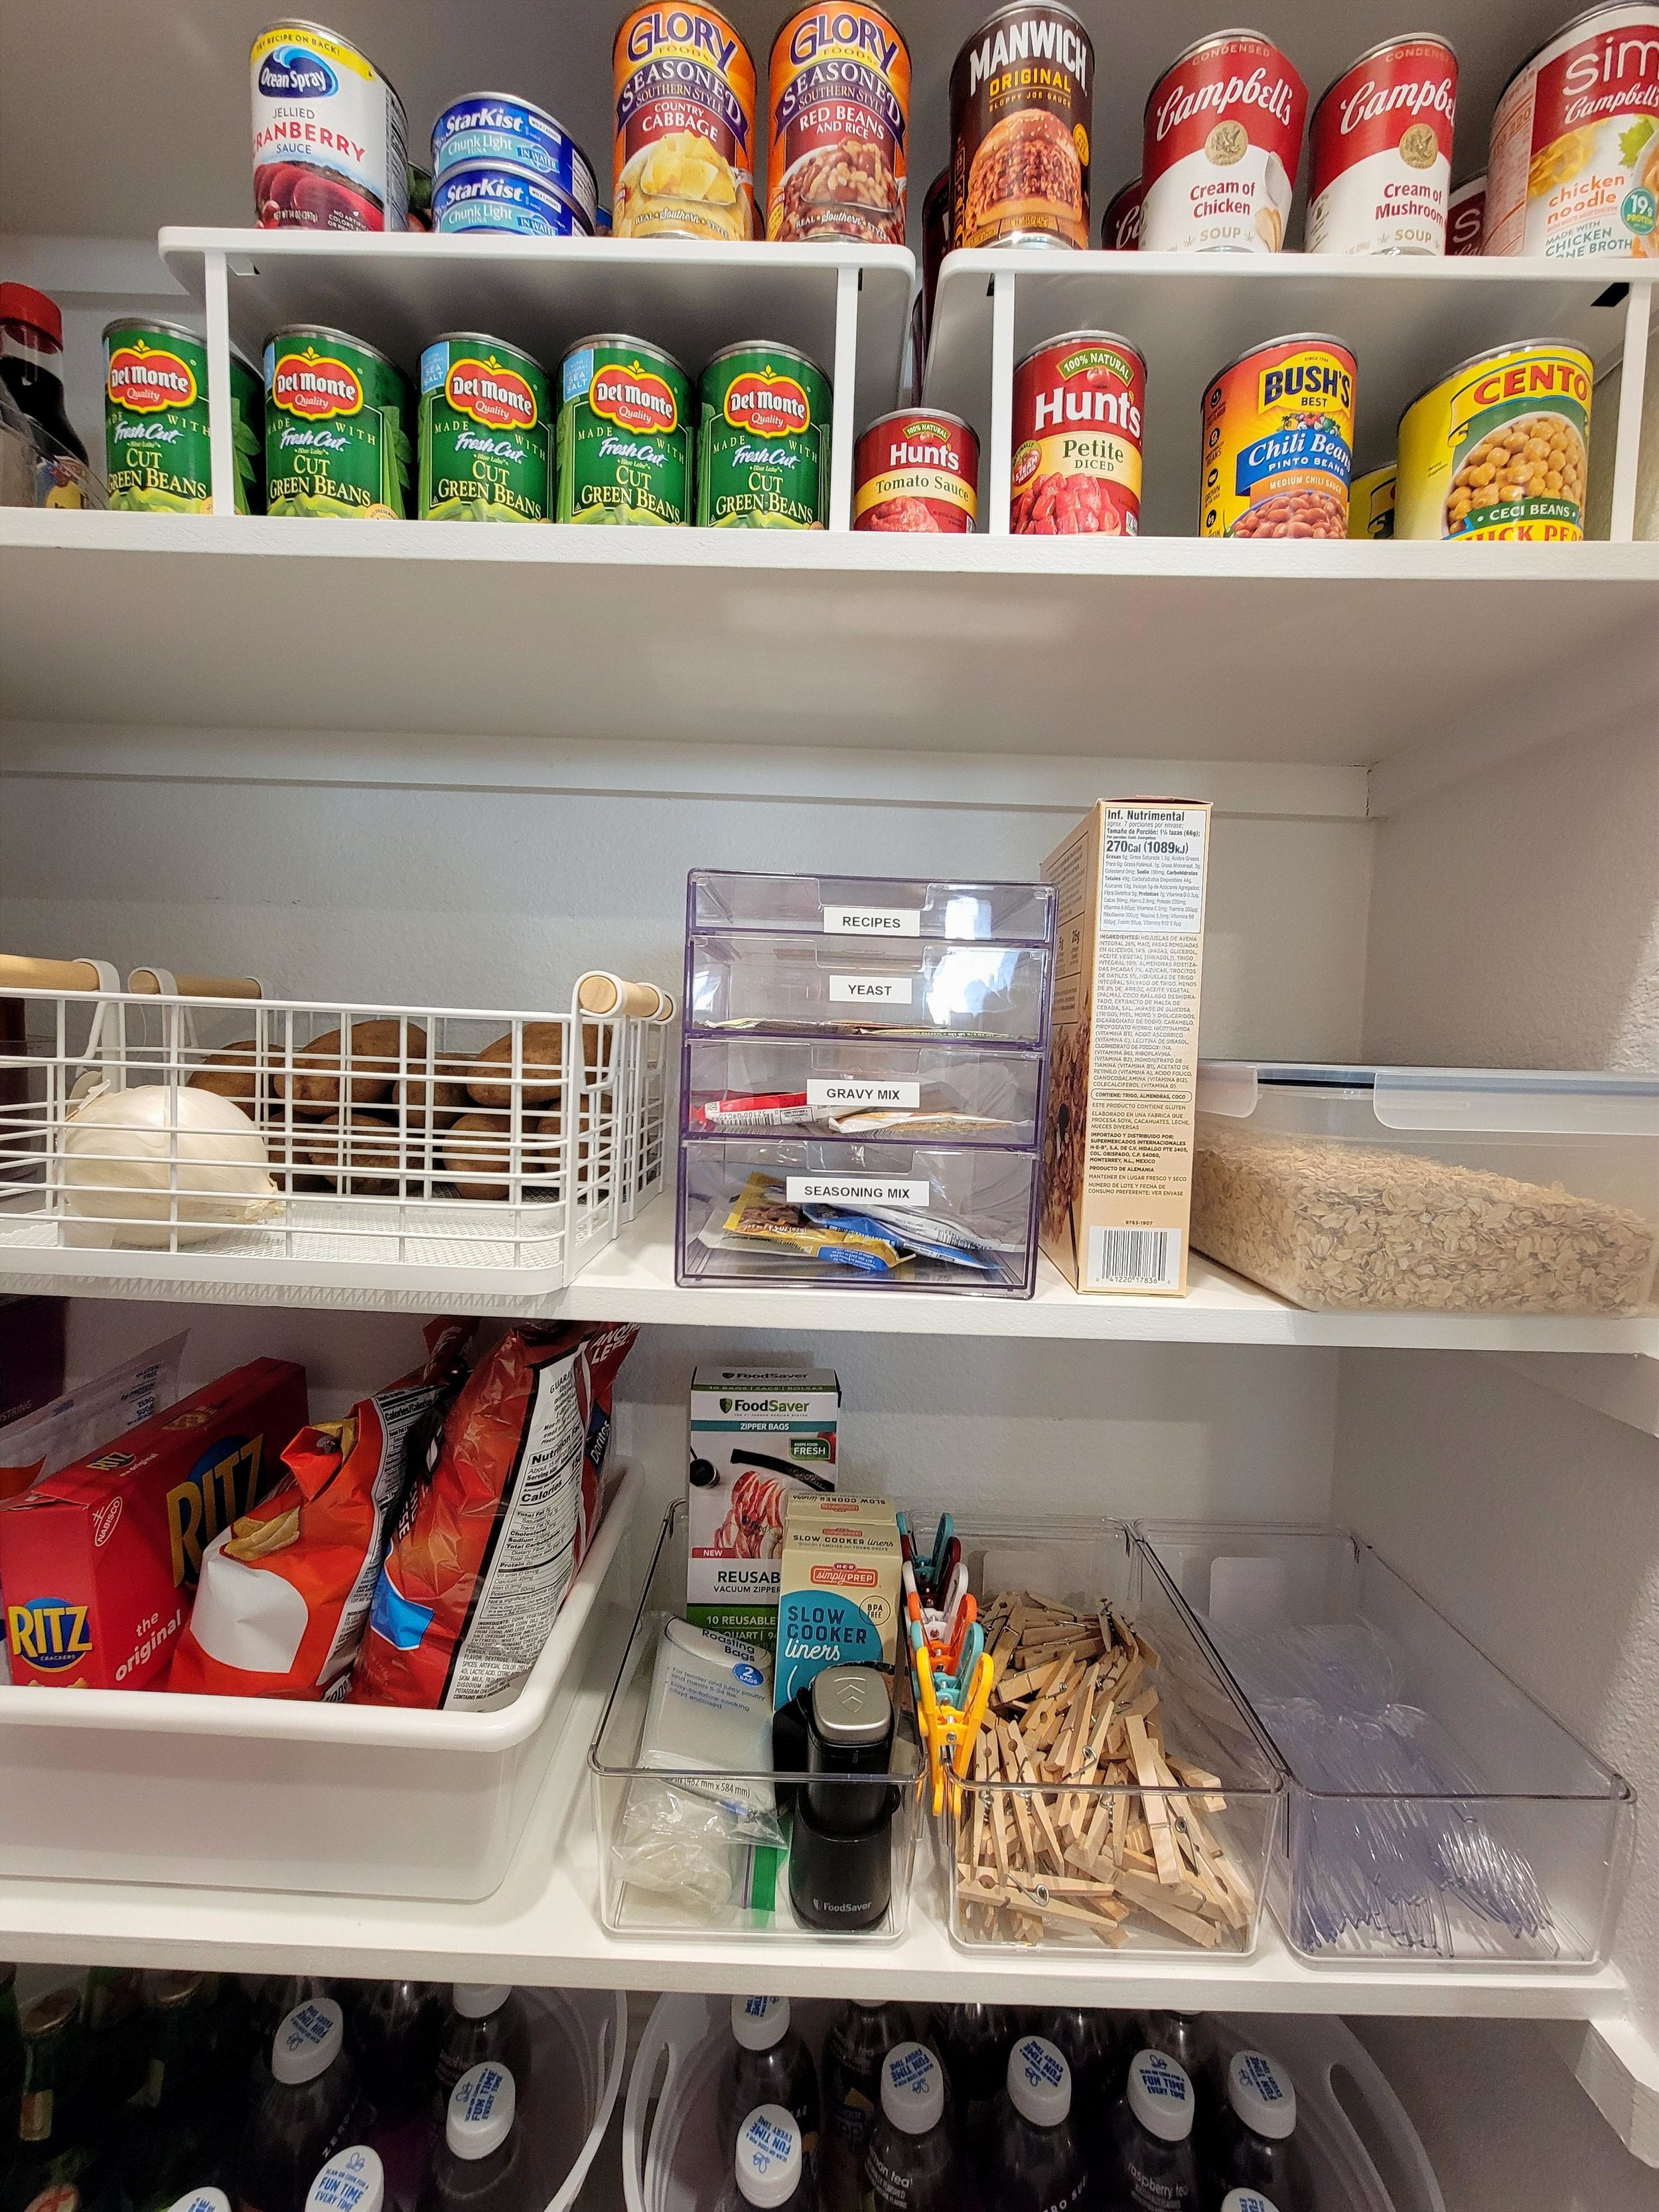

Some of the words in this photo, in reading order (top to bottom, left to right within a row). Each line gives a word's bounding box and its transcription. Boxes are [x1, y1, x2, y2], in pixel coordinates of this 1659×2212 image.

[267, 34, 292, 44] RECIPE
[312, 38, 340, 56] BACK!
[628, 12, 737, 78] GLORY
[790, 14, 899, 80] GLORY
[1192, 44, 1269, 66] CONDENSED
[970, 21, 1087, 98] MANWICH
[261, 67, 289, 88] Ocean
[291, 70, 326, 92] Spray
[989, 68, 1071, 97] ORIGINAL
[622, 61, 741, 123] SEASONED
[636, 84, 691, 107] SOUTHERN
[693, 86, 722, 113] STYLE
[783, 63, 900, 125] SEASONED
[1047, 94, 1070, 108] SAUCE
[1157, 67, 1292, 141] Campbell's
[272, 108, 315, 119] JELLIED
[655, 102, 704, 117] COUNTRY
[1340, 78, 1456, 135] Campbe
[445, 108, 524, 136] StarKist
[642, 112, 719, 143] CABBAGE
[800, 107, 830, 131] RED
[836, 106, 885, 140] BEANS
[816, 121, 841, 135] AND
[845, 122, 869, 140] RICE
[254, 122, 365, 163] RANBERRY
[276, 143, 311, 155] SAUCE
[448, 135, 480, 156] Chunk
[483, 135, 512, 151] Light
[521, 147, 530, 158] IN
[532, 149, 557, 169] WATER
[447, 178, 524, 206] StarKist
[1190, 182, 1238, 200] Cream
[1242, 182, 1256, 197] of
[1384, 183, 1430, 198] Cream
[1433, 189, 1442, 204] of
[1549, 175, 1624, 208] chicken
[449, 205, 481, 224] Chunk
[483, 204, 512, 220] Light
[660, 208, 700, 224] Southern
[822, 210, 861, 225] Southern
[1194, 198, 1251, 218] Chicken
[1375, 200, 1444, 228] Mushroom
[1547, 190, 1617, 225] noodle
[1199, 226, 1241, 242] SOUP
[1395, 229, 1431, 244] SOUP
[1545, 227, 1612, 257] CHICKEN
[1546, 228, 1573, 246] MADE
[1577, 220, 1601, 233] WITH
[1589, 239, 1632, 254] BROTH
[1064, 355, 1088, 372] 100%
[1090, 352, 1129, 380] NATURAL
[111, 366, 129, 388] Del
[132, 366, 188, 393] Monte
[277, 373, 298, 394] Del
[301, 372, 356, 402] Monte
[567, 380, 586, 393] SALT
[568, 373, 586, 384] SEA
[1264, 366, 1350, 409] BUSH'S
[1473, 364, 1588, 405] CENTO
[452, 377, 478, 397] Del
[481, 380, 532, 415] Monte
[597, 383, 622, 402] Del
[625, 385, 672, 419] Monte
[731, 393, 755, 411] Del
[757, 391, 806, 419] Monte
[1301, 397, 1328, 408] BEST
[618, 406, 652, 424] Quality
[751, 412, 784, 427] Quality
[1035, 387, 1141, 439] Hunt's
[907, 425, 920, 435] 100%
[922, 423, 947, 439] NATURAL
[578, 427, 613, 441] MADE
[656, 438, 685, 465] WITH
[599, 437, 637, 457] Fresh
[636, 443, 669, 468] Cut
[890, 442, 959, 471] Hunt's
[1062, 439, 1123, 463] Petite
[1248, 433, 1306, 467] Chili
[293, 455, 330, 476] CUT
[472, 460, 510, 486] CUT
[1074, 459, 1114, 473] DICED
[1268, 456, 1309, 473] PINTO
[1313, 457, 1344, 477] BEANS
[108, 470, 143, 494] GREEN
[146, 469, 206, 499] BEANS
[616, 466, 652, 490] CUT
[749, 472, 784, 494] CUT
[876, 475, 929, 494] Tomato
[934, 476, 969, 502] Sauce
[1269, 476, 1303, 490] MEDIUM
[1305, 476, 1324, 485] CHILI
[1326, 479, 1342, 494] SAUCE
[270, 477, 310, 499] GREEN
[315, 475, 371, 506] BEANS
[438, 479, 490, 498] GREEN
[494, 482, 541, 520] BEANS
[581, 484, 632, 505] GREEN
[637, 488, 680, 524] BEANS
[715, 496, 763, 516] GREEN
[769, 493, 814, 524] BEANS
[1488, 505, 1525, 522] CECI
[1530, 504, 1571, 518] BEANS
[1108, 810, 1123, 820] Inf.
[1127, 810, 1185, 821] Nutrimental
[1106, 840, 1141, 853] 270Cal
[1143, 841, 1189, 854] (1089kJ)
[842, 915, 901, 928] RECIPES
[847, 984, 893, 997] YEAST
[826, 1088, 875, 1100] GRAVY
[877, 1090, 901, 1101] MIX
[804, 1186, 883, 1199] SEASONING
[886, 1187, 910, 1199] MIX
[735, 1400, 810, 1412] FoodSaver
[794, 1447, 826, 1455] FRESH
[96, 1498, 121, 1544] NABISCO
[793, 1534, 821, 1543] SLOW
[825, 1536, 864, 1545] COOKER
[867, 1537, 894, 1547] liners
[706, 1615, 719, 1625] 10
[721, 1616, 776, 1625] REUSABLE
[787, 1605, 845, 1625] SLOW
[867, 1604, 883, 1613] BPA
[7, 1605, 92, 1657] RITZ
[135, 1611, 159, 1637] the
[786, 1623, 867, 1645] COOKER
[115, 1609, 182, 1682] original
[701, 1629, 755, 1654] Roasting
[724, 1645, 756, 1662] Bags
[784, 1638, 841, 1661] liners
[824, 1901, 872, 1912] FoodSaver
[315, 2191, 336, 2205] EVERY
[336, 2198, 354, 2212] TIME
[319, 2176, 340, 2193] FUN
[340, 2183, 365, 2203] TIME
